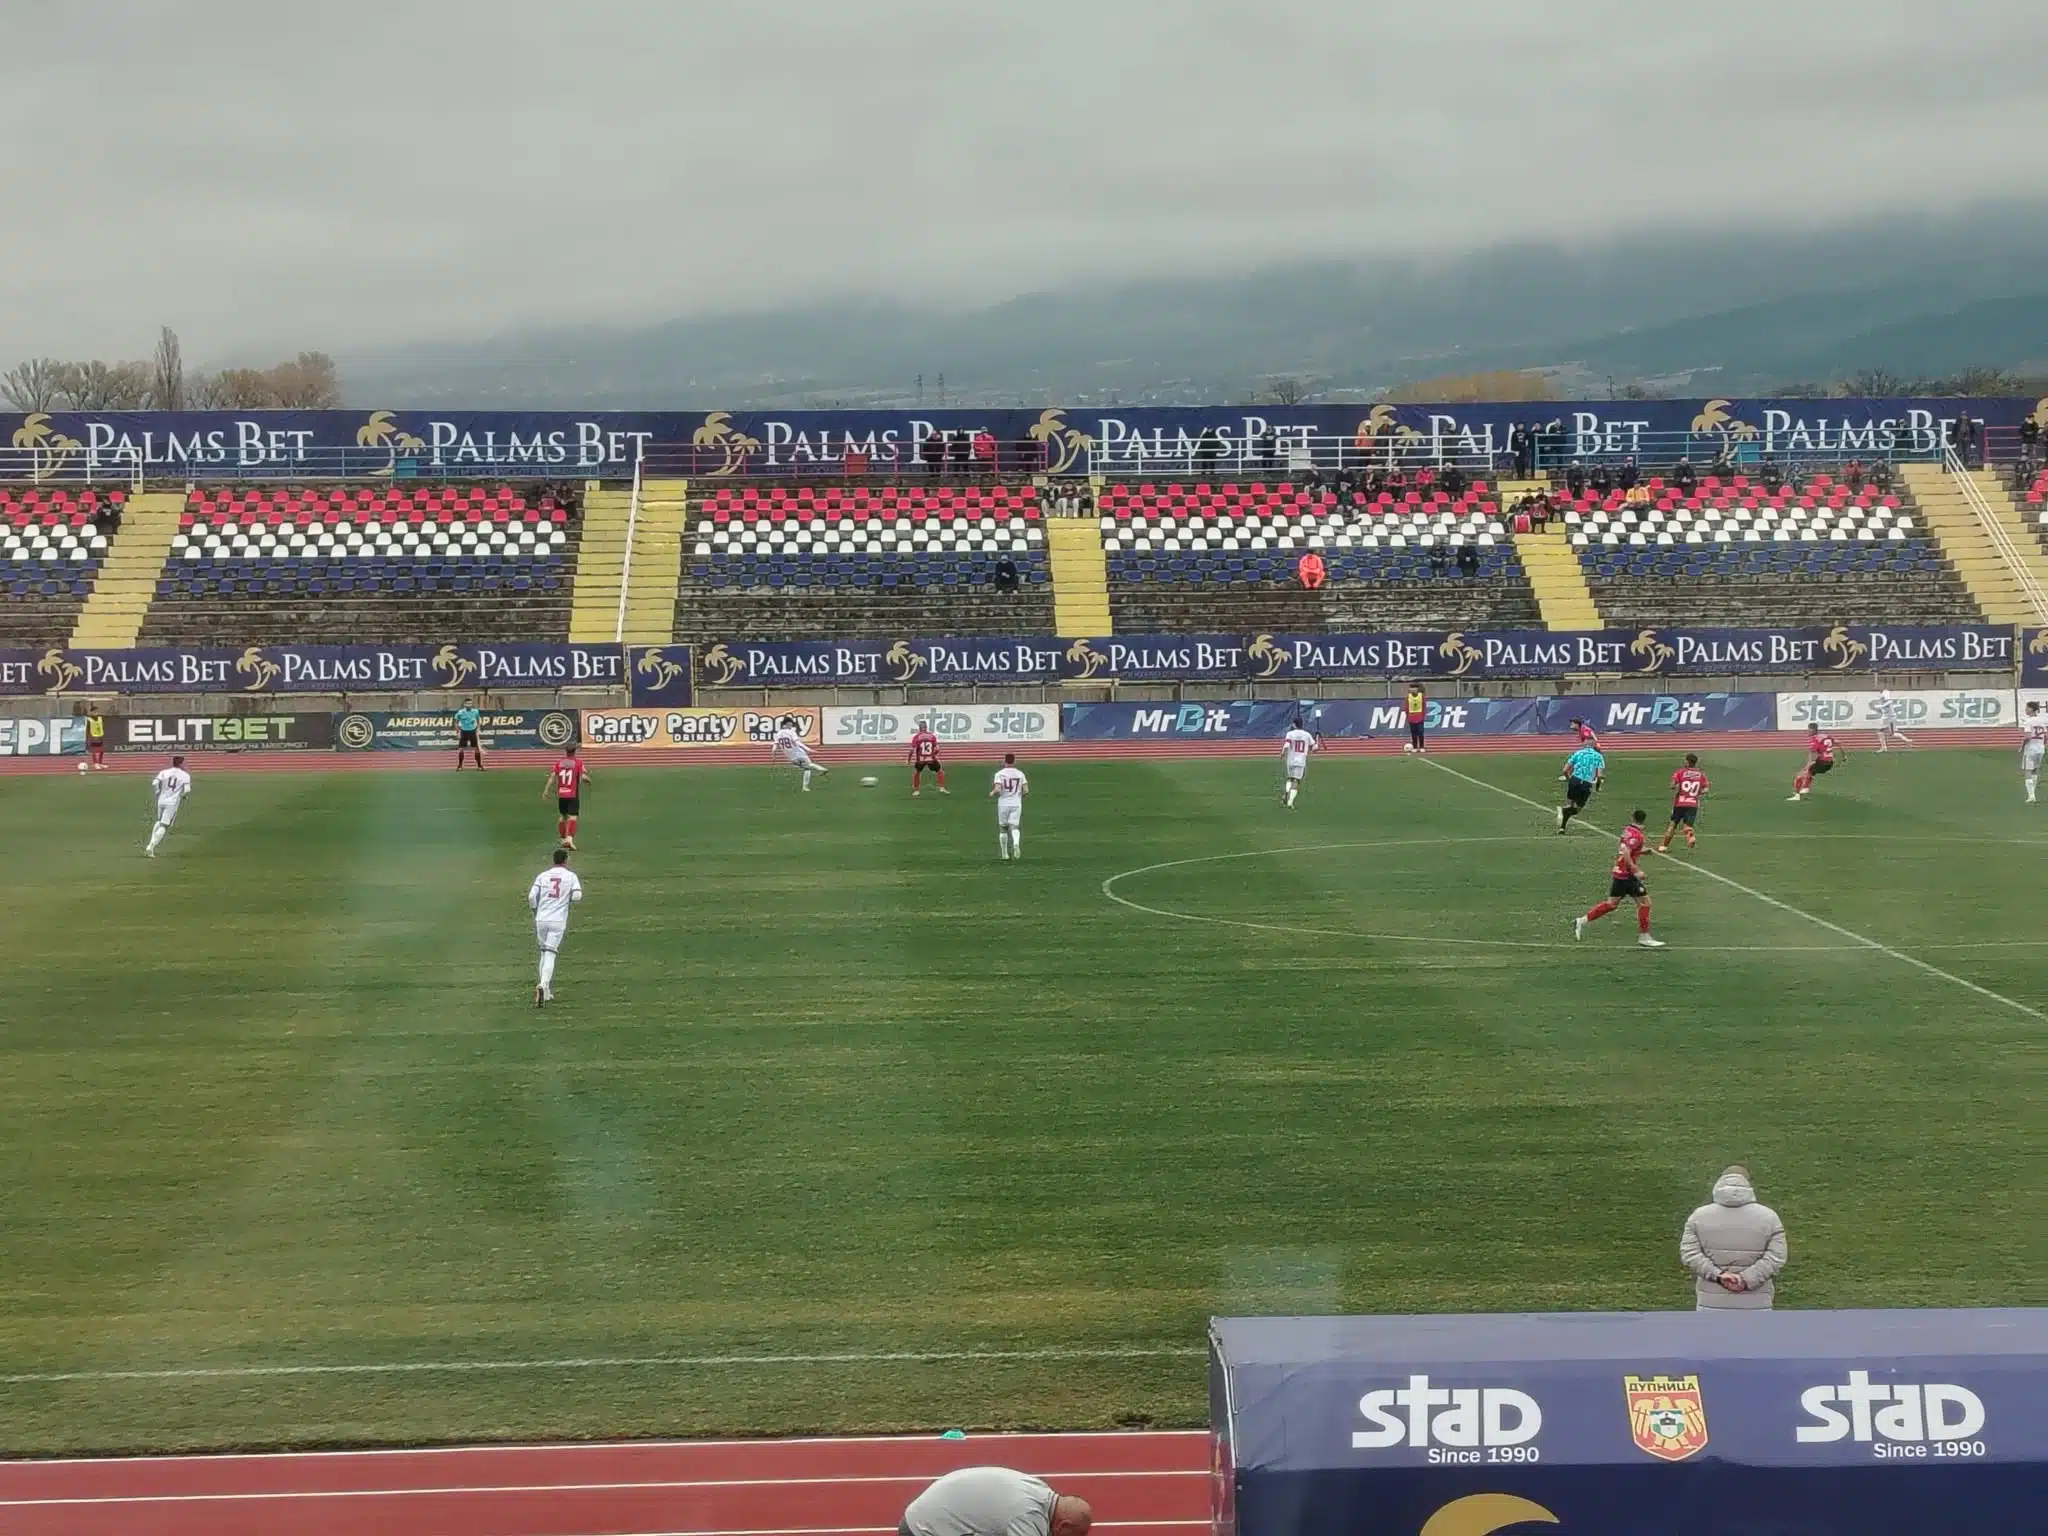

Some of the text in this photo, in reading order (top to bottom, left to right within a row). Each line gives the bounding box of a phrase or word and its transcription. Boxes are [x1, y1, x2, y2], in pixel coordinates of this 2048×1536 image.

[86, 422, 314, 466] PALMS BET
[429, 422, 652, 466] PALMS BET
[764, 422, 898, 465] PALMS
[1429, 412, 1648, 456] PAL BET
[1762, 410, 1896, 452] PALMS
[929, 646, 1061, 674] PALMS BET
[1110, 644, 1242, 672] PALMS BET
[1294, 640, 1434, 669] PALMS BET
[1484, 637, 1625, 667] PALMS BET
[1677, 636, 1818, 664] PALMS BET
[1869, 632, 2011, 662] PALMS BET
[0, 662, 32, 683] ET
[84, 654, 231, 684] PALMS BET
[282, 652, 427, 682] PALMS BET
[478, 650, 621, 679] PALMS BET
[748, 648, 881, 677] PALMS BET
[387, 717, 453, 728] АМЕРИКАН
[492, 716, 524, 726] КЕАР
[589, 715, 658, 738] Party
[667, 714, 737, 738] Party
[1132, 704, 1230, 732] MrBit
[1607, 697, 1706, 725] MrBit
[128, 717, 295, 742] ELITBET
[920, 742, 932, 755] 13
[168, 776, 178, 792] 4
[559, 769, 572, 786] 11
[1004, 778, 1020, 792] 47
[548, 878, 562, 898] 3
[1629, 1382, 1696, 1392] ДУПНИЦА
[1428, 1447, 1540, 1464] Since 1990
[1874, 1441, 1986, 1458] Since 1990
